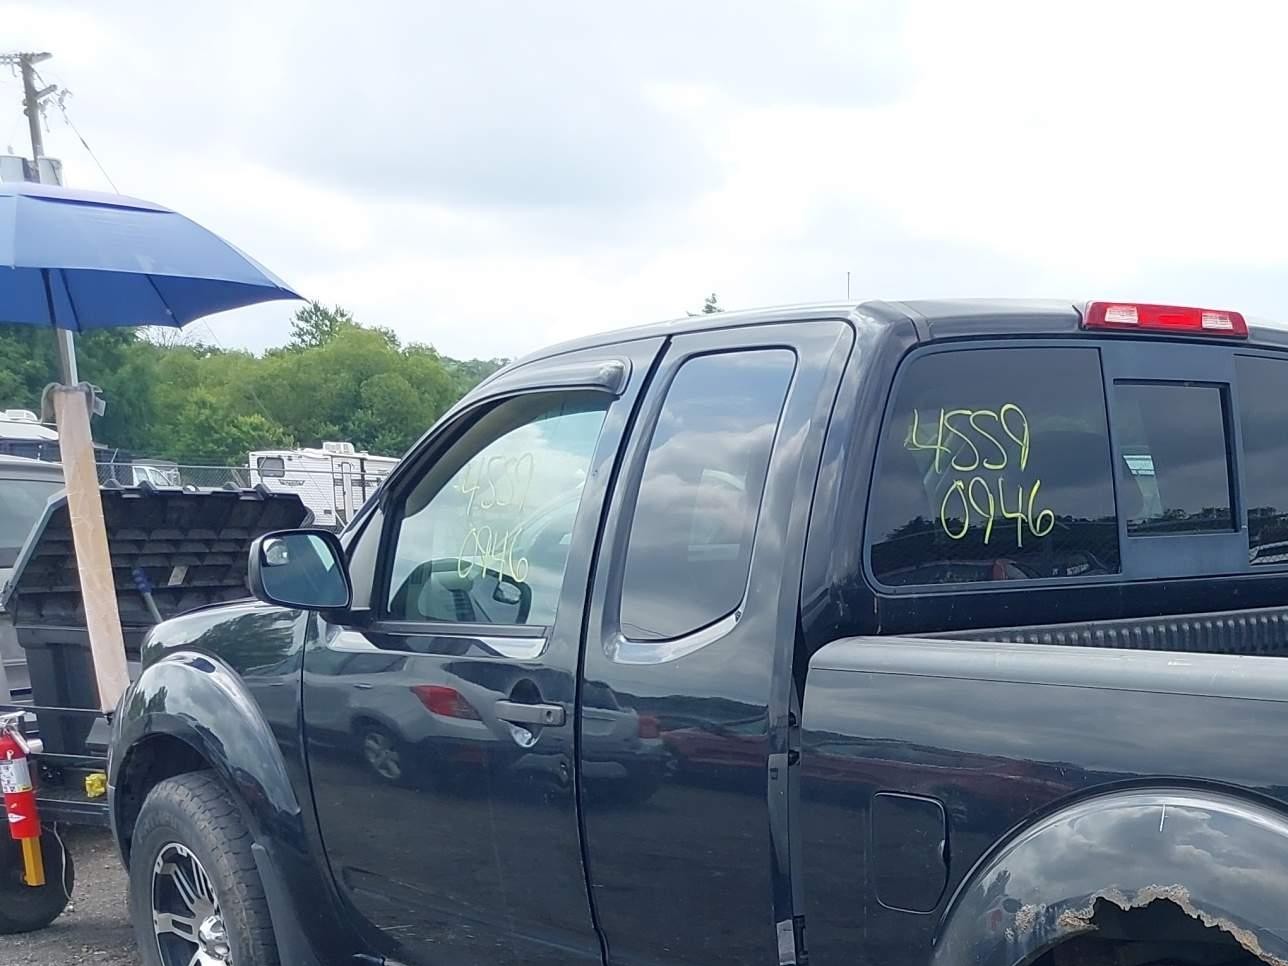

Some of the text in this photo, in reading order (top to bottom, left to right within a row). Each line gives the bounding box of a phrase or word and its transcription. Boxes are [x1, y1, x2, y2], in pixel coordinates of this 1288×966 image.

[910, 404, 1030, 474] 4559
[940, 476, 1055, 548] 0946
[457, 523, 529, 583] 0946
